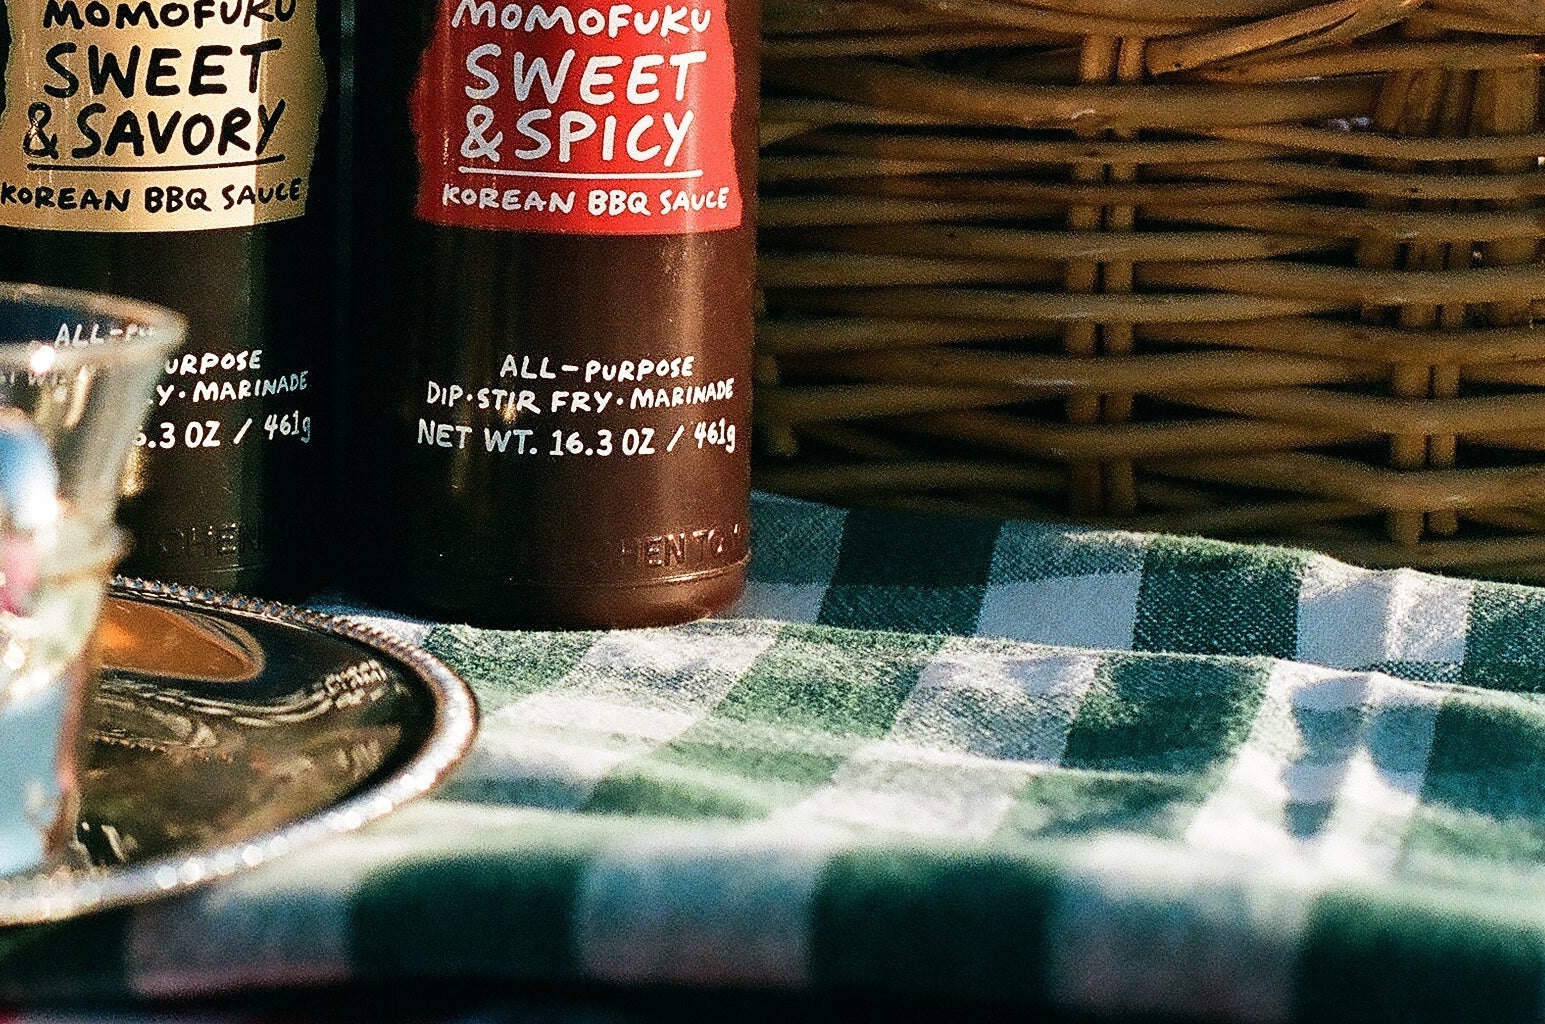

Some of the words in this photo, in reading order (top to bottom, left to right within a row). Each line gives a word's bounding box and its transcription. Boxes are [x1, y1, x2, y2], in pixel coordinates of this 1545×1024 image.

[43, 38, 283, 99] SWEET
[464, 43, 707, 105] SWEET
[23, 101, 59, 160] &
[71, 98, 287, 157] SAVORY
[460, 105, 504, 163] &
[514, 108, 694, 167] SPICY
[0, 181, 131, 212] KOREAN
[144, 185, 212, 213] BBQ
[223, 177, 303, 210] SAUCE
[441, 183, 576, 214] KOREAN
[587, 189, 652, 216] BBQ
[659, 186, 730, 215] SAUCE
[163, 349, 263, 375] URPOSE
[499, 354, 696, 383] ALL-PURPOSE
[184, 420, 221, 449] OZ
[263, 410, 312, 444] 461g
[417, 418, 473, 450] NET
[483, 427, 539, 455] WT.
[549, 429, 614, 456] 16.3
[621, 427, 656, 455] OZ
[692, 416, 737, 454] 461g
